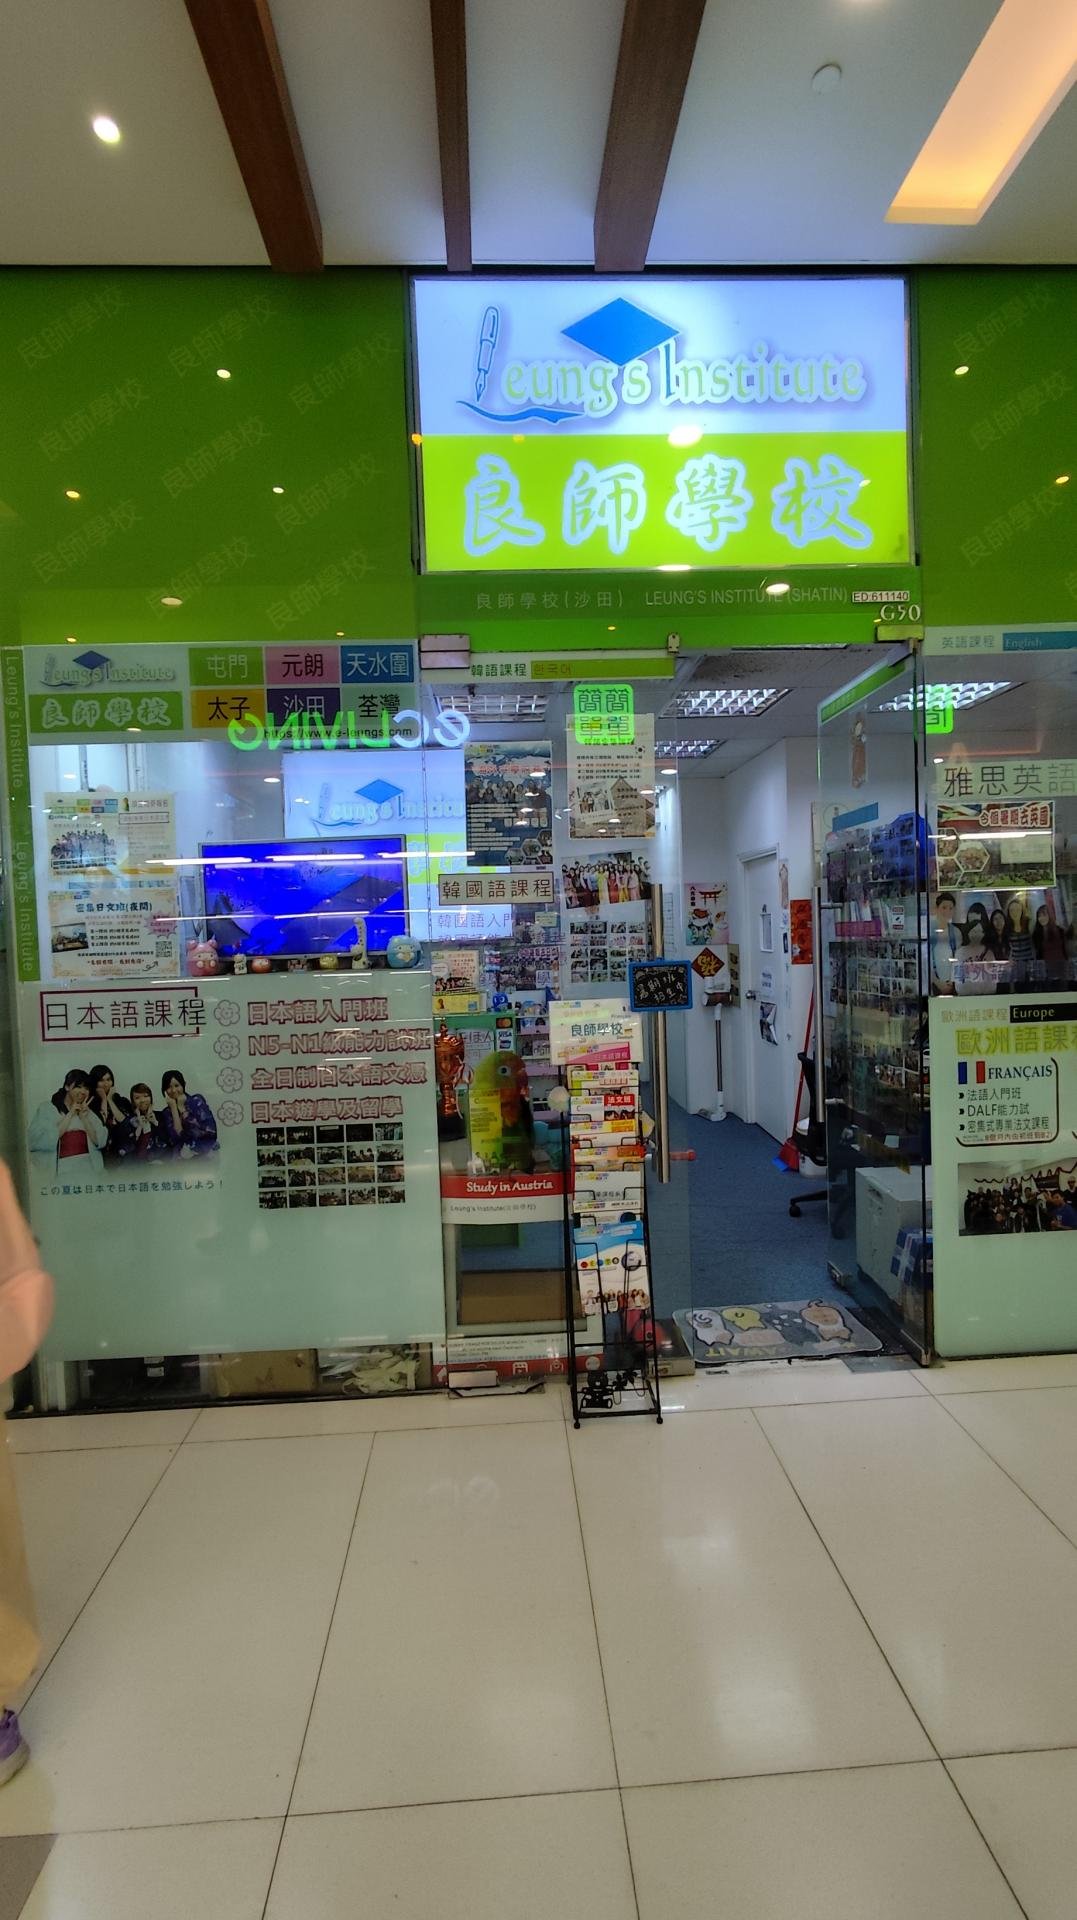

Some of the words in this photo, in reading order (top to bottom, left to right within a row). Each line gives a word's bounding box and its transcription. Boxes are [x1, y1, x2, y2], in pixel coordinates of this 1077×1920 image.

[660, 340, 866, 404] Institute
[464, 453, 873, 557] 良師學校
[645, 587, 707, 606] LEUNG'S
[787, 586, 849, 605] (SHATIN)
[880, 604, 921, 621] G50
[1004, 637, 1042, 651] English
[206, 654, 248, 679] 屯門
[282, 653, 324, 678] 元朗
[346, 652, 409, 677] 天水圍
[471, 663, 527, 677] 韓語課程
[5, 656, 20, 719] Leung's
[42, 697, 171, 729] 良師學校
[208, 697, 250, 721] 太子
[283, 695, 326, 720] 沙田
[358, 693, 401, 720] 荃灣
[8, 724, 24, 788] Institute
[944, 763, 1076, 797] 雅思英語
[16, 841, 32, 904] Leung's
[442, 879, 552, 899] 韓國語課程
[19, 908, 35, 972] Institute
[46, 998, 207, 1031] 日本語課程
[248, 996, 389, 1026] 日本語入門班
[1012, 1007, 1056, 1020] Europe
[955, 1024, 1077, 1057] 歐洲語課
[251, 1062, 428, 1090] 全日制日本語文憑
[988, 1064, 1053, 1081] FRANÇAIS
[967, 1087, 1022, 1101] 法語入門班
[251, 1095, 404, 1124] 日本遊學及留學
[967, 1103, 1030, 1117] DALF能力試
[466, 1180, 498, 1196] Study
[499, 1181, 511, 1192] in
[512, 1179, 554, 1191] Austria
